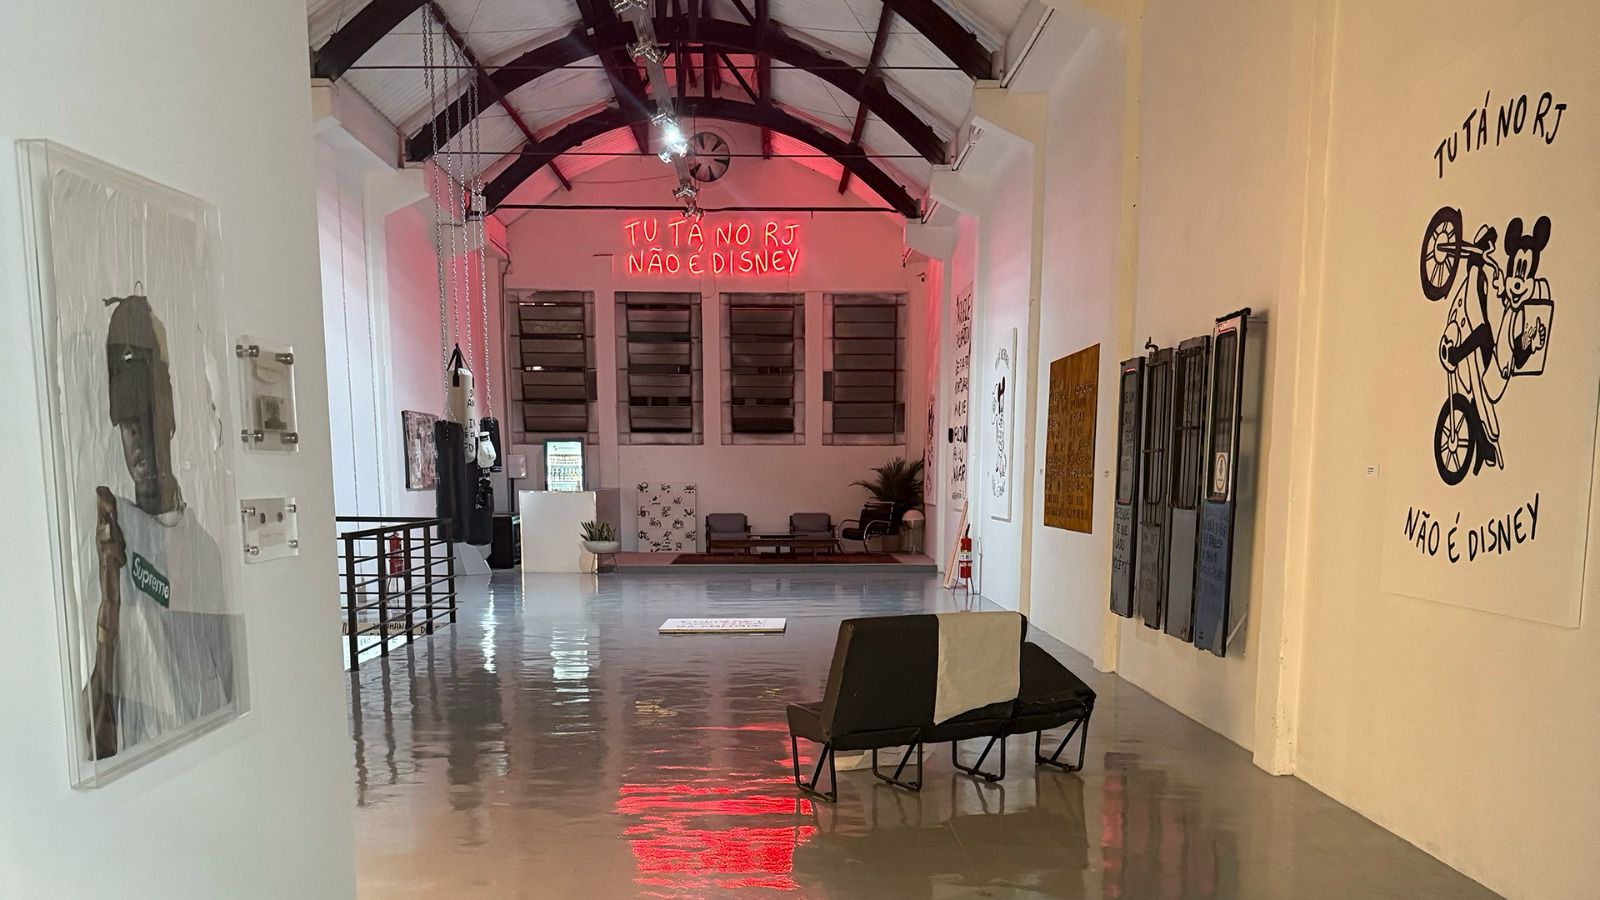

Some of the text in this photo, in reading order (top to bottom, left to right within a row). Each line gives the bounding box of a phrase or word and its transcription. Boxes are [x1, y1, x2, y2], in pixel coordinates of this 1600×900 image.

[1434, 89, 1567, 179] TU TÁ NO RJ
[624, 217, 799, 247] TU TÁ NO RJ
[628, 244, 799, 276] NÃO É DISNEY
[1404, 492, 1539, 564] NÃO É DISNEY
